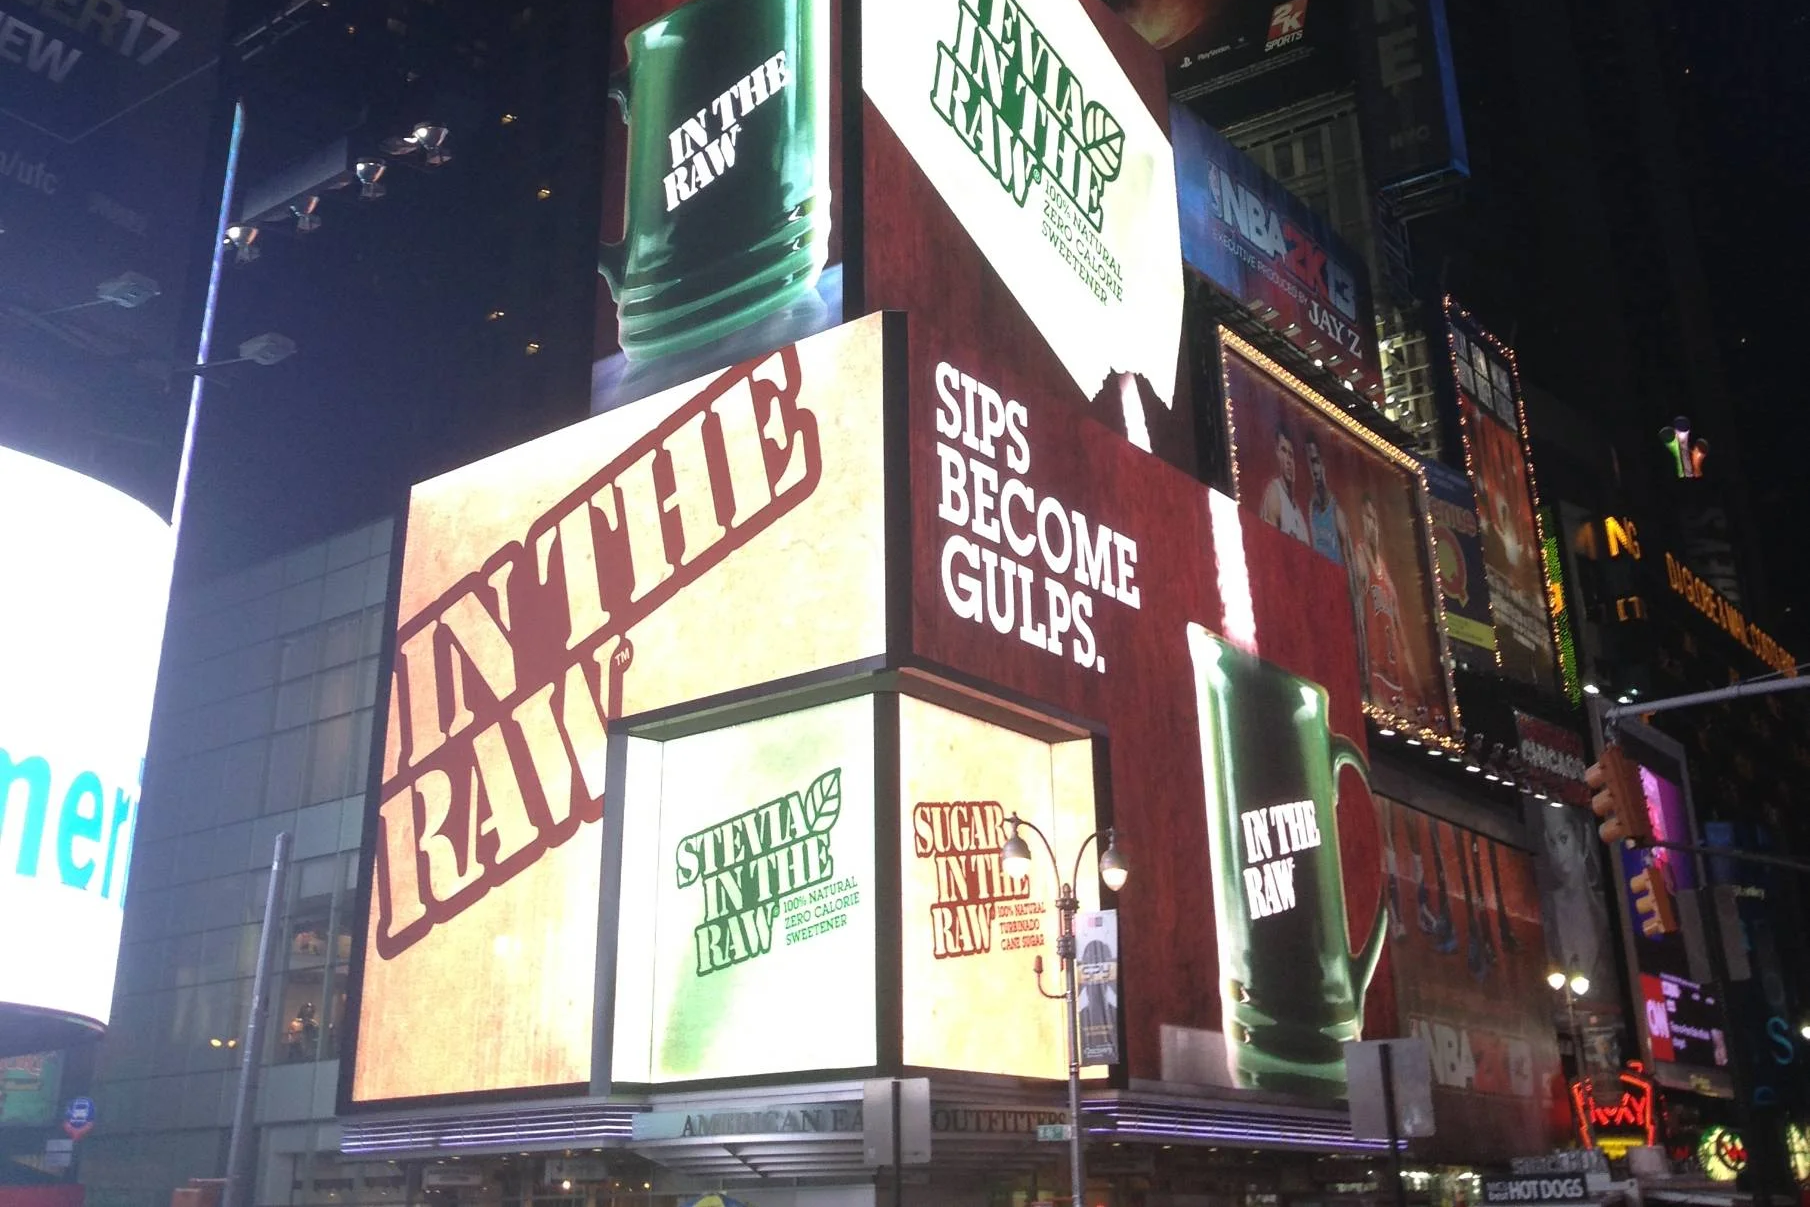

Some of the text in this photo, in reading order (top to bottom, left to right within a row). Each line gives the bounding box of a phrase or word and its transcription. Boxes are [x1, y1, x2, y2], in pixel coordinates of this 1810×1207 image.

[0, 10, 83, 84] EW
[1264, 29, 1303, 53] SPORTS
[669, 50, 790, 168] IN THE
[930, 40, 1037, 208] RAW
[663, 124, 742, 212] RAW
[1015, 70, 1104, 234] THE
[1043, 199, 1123, 302] ZERO CALORIE
[1044, 180, 1123, 282] 100% NATURAL
[1219, 169, 1287, 262] NBA
[1041, 219, 1108, 307] SWEETENER
[935, 361, 1031, 475] SIPS
[399, 347, 818, 771] IN THE
[936, 441, 1142, 611] BECOME
[941, 534, 1106, 674] GULPS.
[375, 634, 621, 944] RAW
[913, 801, 1008, 858] SUGAR
[676, 790, 811, 889] STEVIA
[1241, 799, 1321, 864] IN THE
[703, 831, 833, 924] IN THE
[783, 875, 859, 915] 100% NATURAL
[784, 890, 861, 930] ZERO CALORIE
[935, 854, 969, 904] IN
[1242, 856, 1296, 920] RAW
[695, 900, 778, 977] RAW
[785, 913, 849, 947] SWEETENER
[930, 901, 992, 960] RAW
[999, 918, 1041, 935] TURBINADO
[681, 1107, 822, 1139] AMERICAN
[931, 1108, 1067, 1134] OUTFITTERS
[1509, 1180, 1538, 1200] HOT
[1540, 1178, 1584, 1199] DOGS
